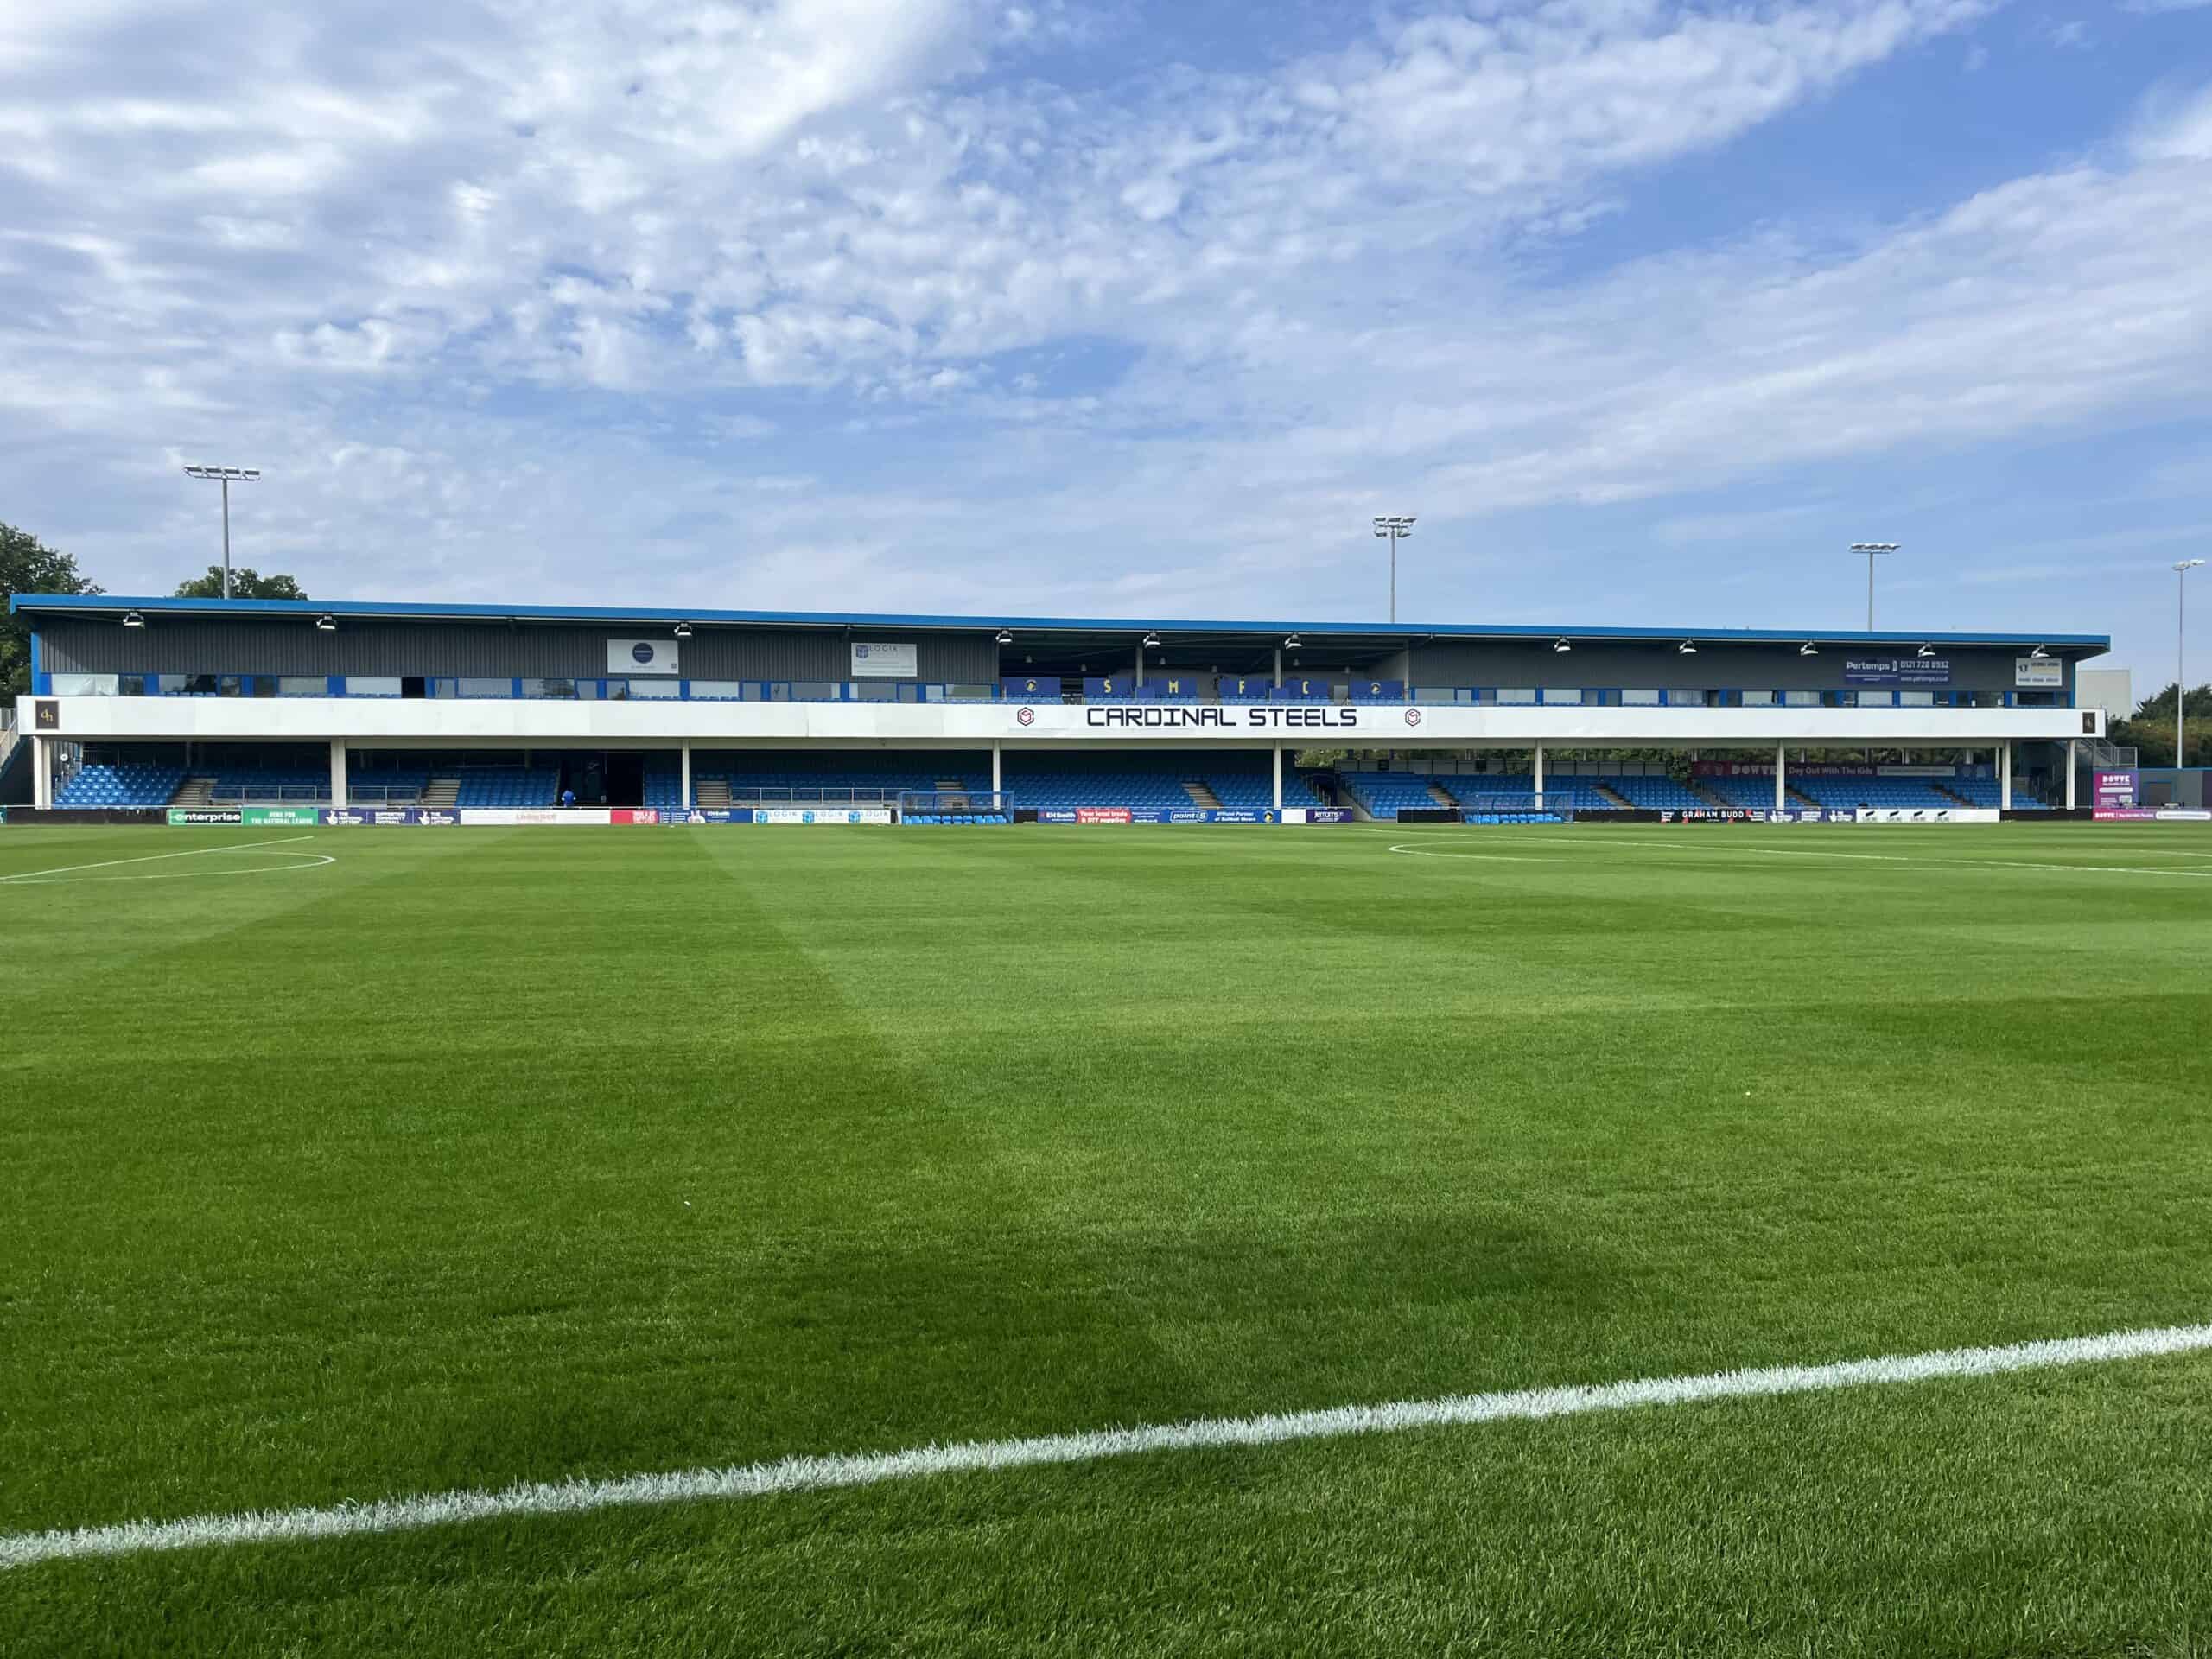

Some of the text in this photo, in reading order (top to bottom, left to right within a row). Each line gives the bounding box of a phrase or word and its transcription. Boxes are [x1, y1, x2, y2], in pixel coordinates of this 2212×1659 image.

[1846, 660, 1890, 671] Pertemps
[1104, 679, 1310, 695] S M F C
[1087, 708, 1357, 727] CARDINAL STEELS
[175, 812, 241, 822] enterprise
